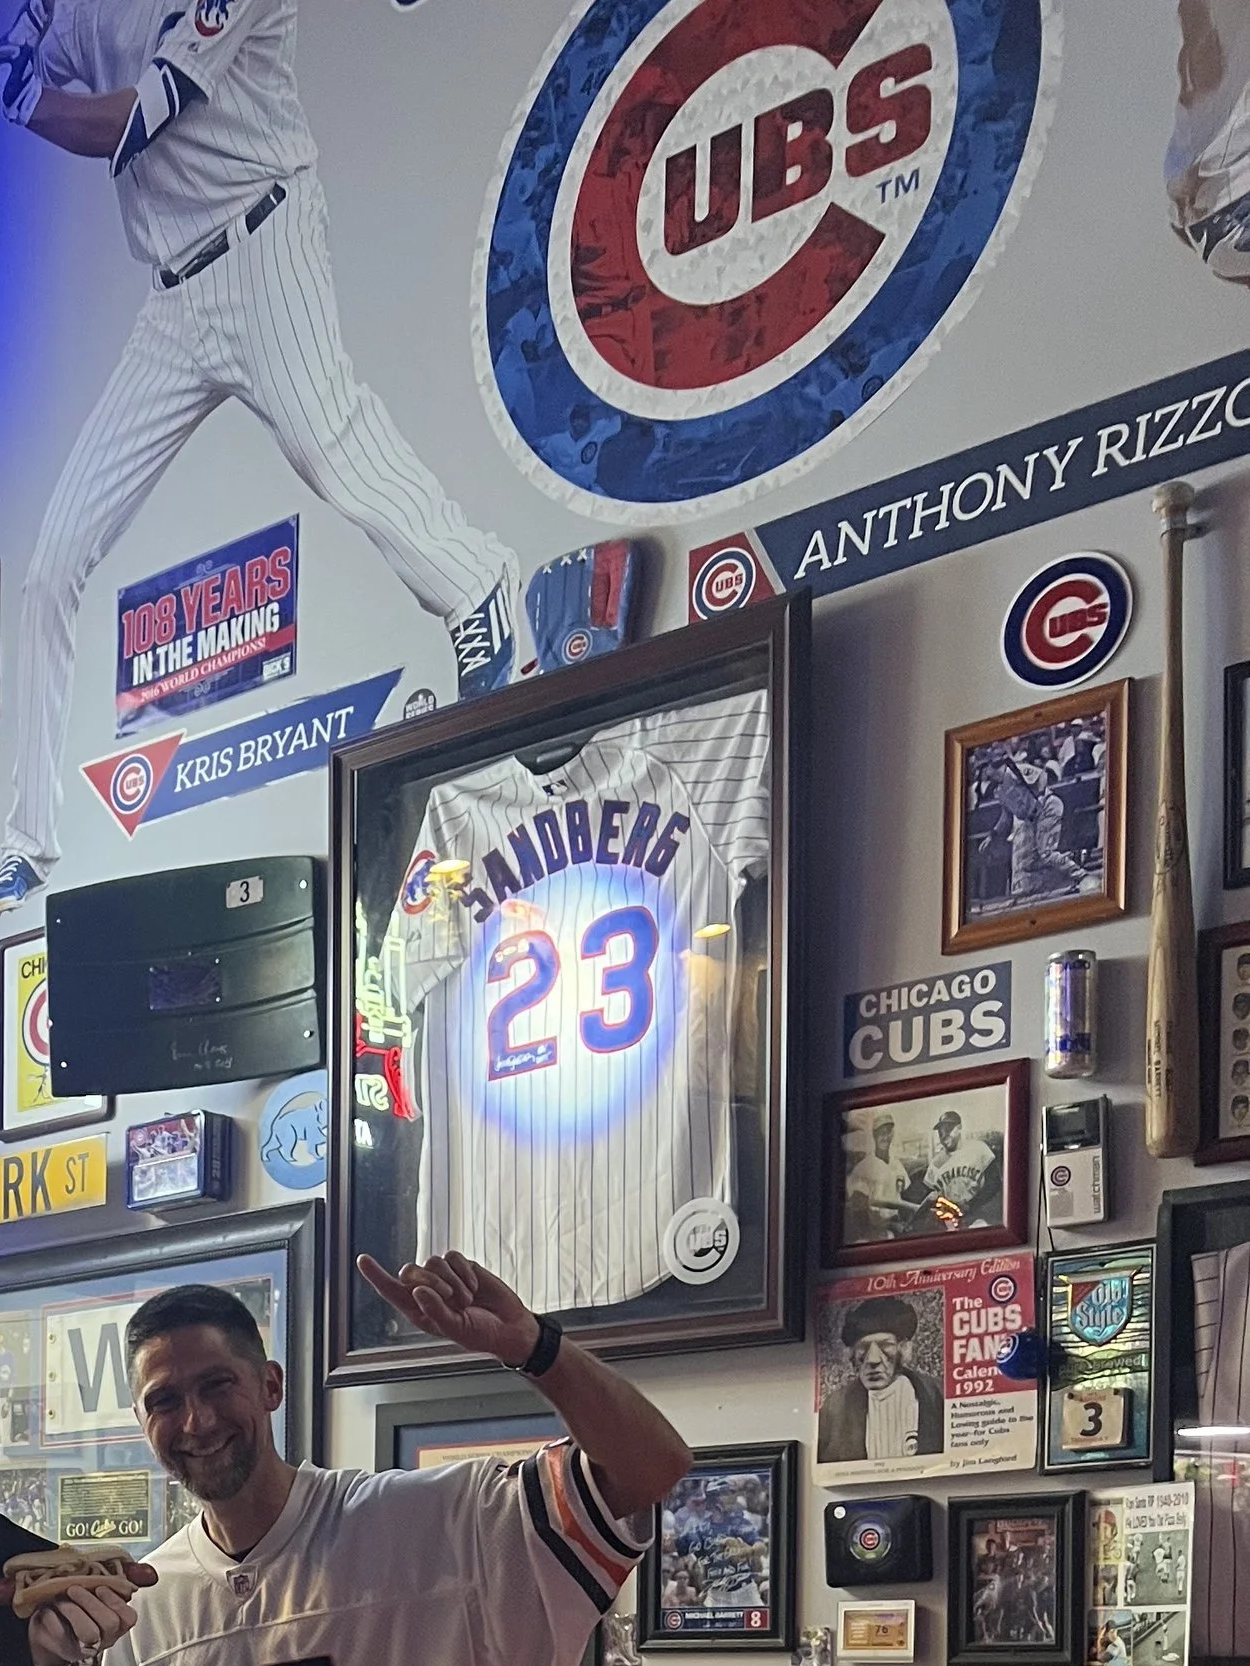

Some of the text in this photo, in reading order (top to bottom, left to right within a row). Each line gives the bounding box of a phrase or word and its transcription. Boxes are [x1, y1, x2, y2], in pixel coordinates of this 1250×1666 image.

[794, 437, 1087, 580] ANTHONY
[122, 546, 292, 660] 108 YEARS
[705, 563, 744, 607] CUBS
[132, 601, 280, 686] IN THE MAKING
[161, 668, 200, 693] WORLD
[200, 637, 267, 673] CHAMPIONS!
[174, 706, 354, 792] KRIS BRYANT
[238, 881, 251, 903] 3
[487, 905, 662, 1083] 23
[859, 969, 997, 1018] CHICAGO
[849, 1000, 1007, 1071] CUBS
[64, 1152, 91, 1196] ST
[900, 1266, 978, 1288] Anniversary
[980, 1257, 1020, 1277] Edition
[1091, 1279, 1123, 1305] Old
[953, 1296, 983, 1311] The
[953, 1303, 1022, 1336] CUBS
[1076, 1301, 1124, 1332] Style
[67, 1322, 134, 1414] W
[955, 1380, 995, 1396] 1992
[1079, 1401, 1104, 1438] 3
[66, 1522, 90, 1537] GO!
[118, 1519, 143, 1535] GO!
[750, 1610, 762, 1628] 8
